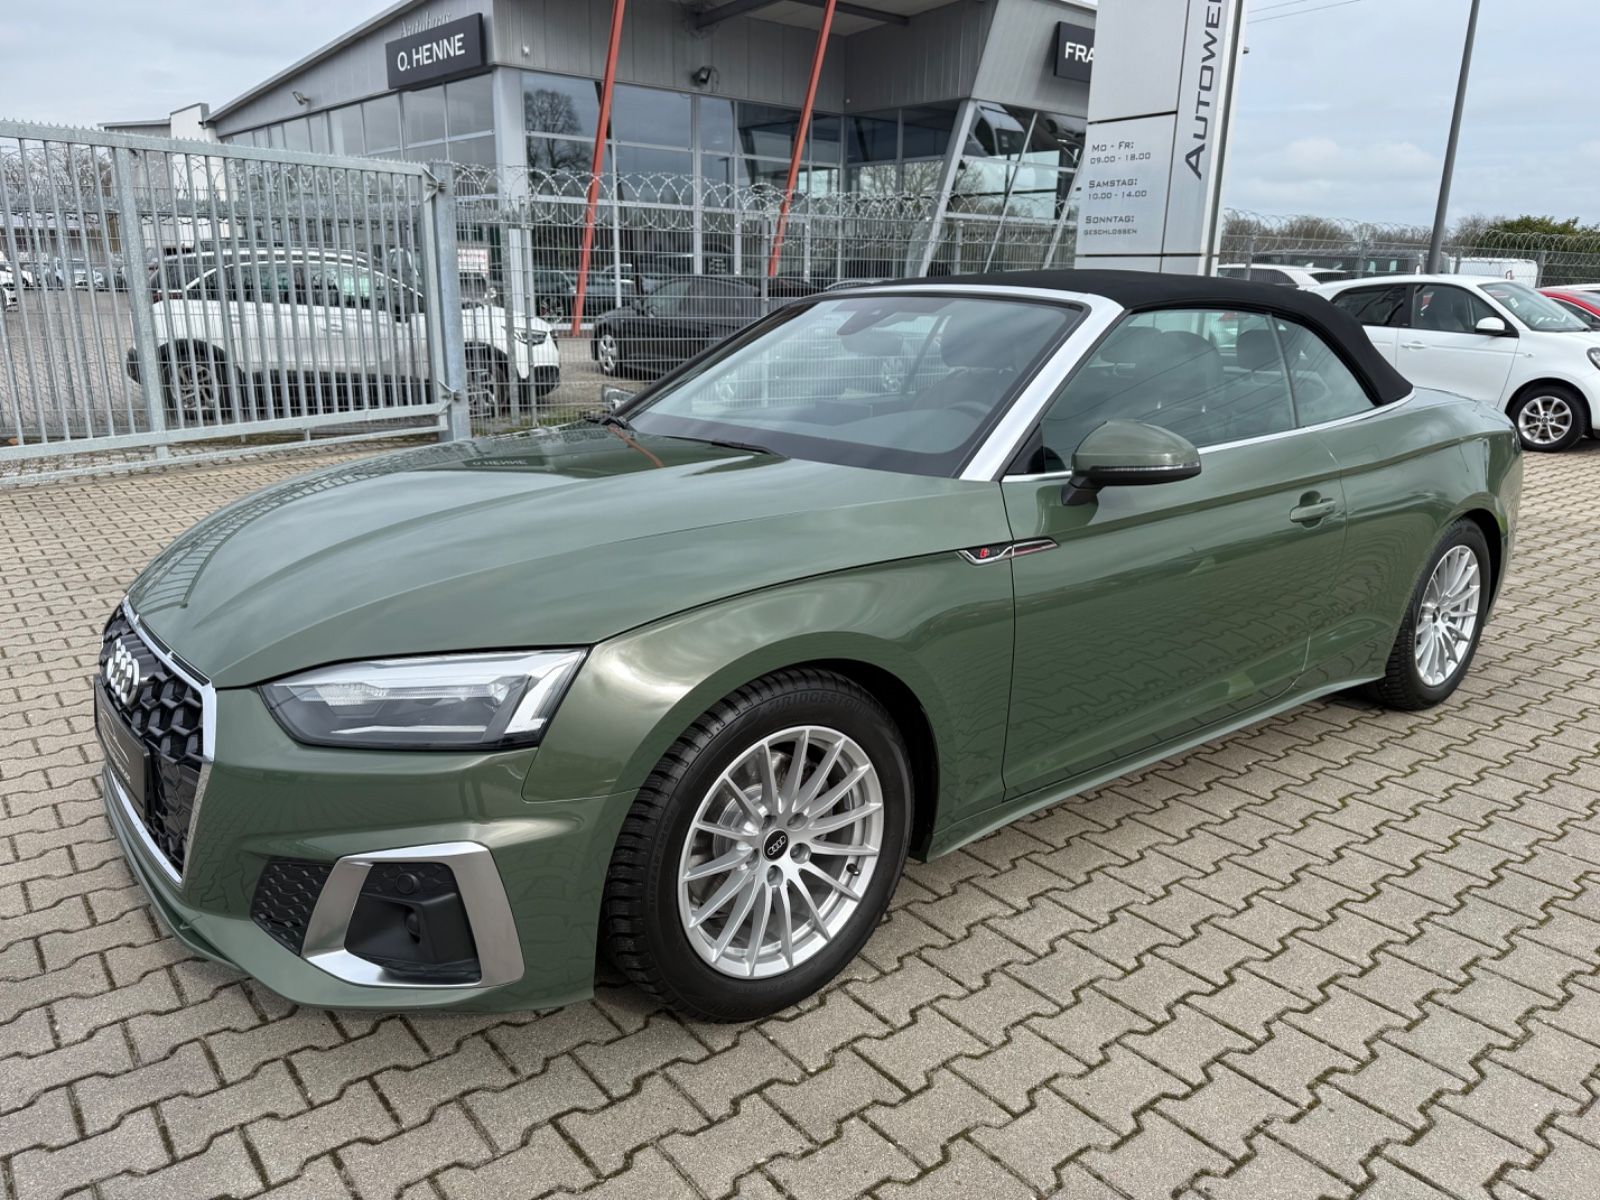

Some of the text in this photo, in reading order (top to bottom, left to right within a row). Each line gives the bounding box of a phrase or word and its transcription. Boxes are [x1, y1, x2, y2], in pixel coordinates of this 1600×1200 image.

[397, 33, 466, 72] O. HENNE
[1185, 0, 1222, 180] AUTOWE
[1091, 144, 1107, 152] MO
[1118, 140, 1135, 150] FR:
[1089, 155, 1116, 165] 09.00
[1125, 152, 1151, 161] 18.00
[1088, 178, 1138, 189] SAMSTAG:
[1088, 191, 1113, 200] 10.00
[1122, 190, 1147, 199] 14.00
[1085, 215, 1135, 224] SONNTAG:
[1083, 228, 1138, 236] GESCHLOSSEN
